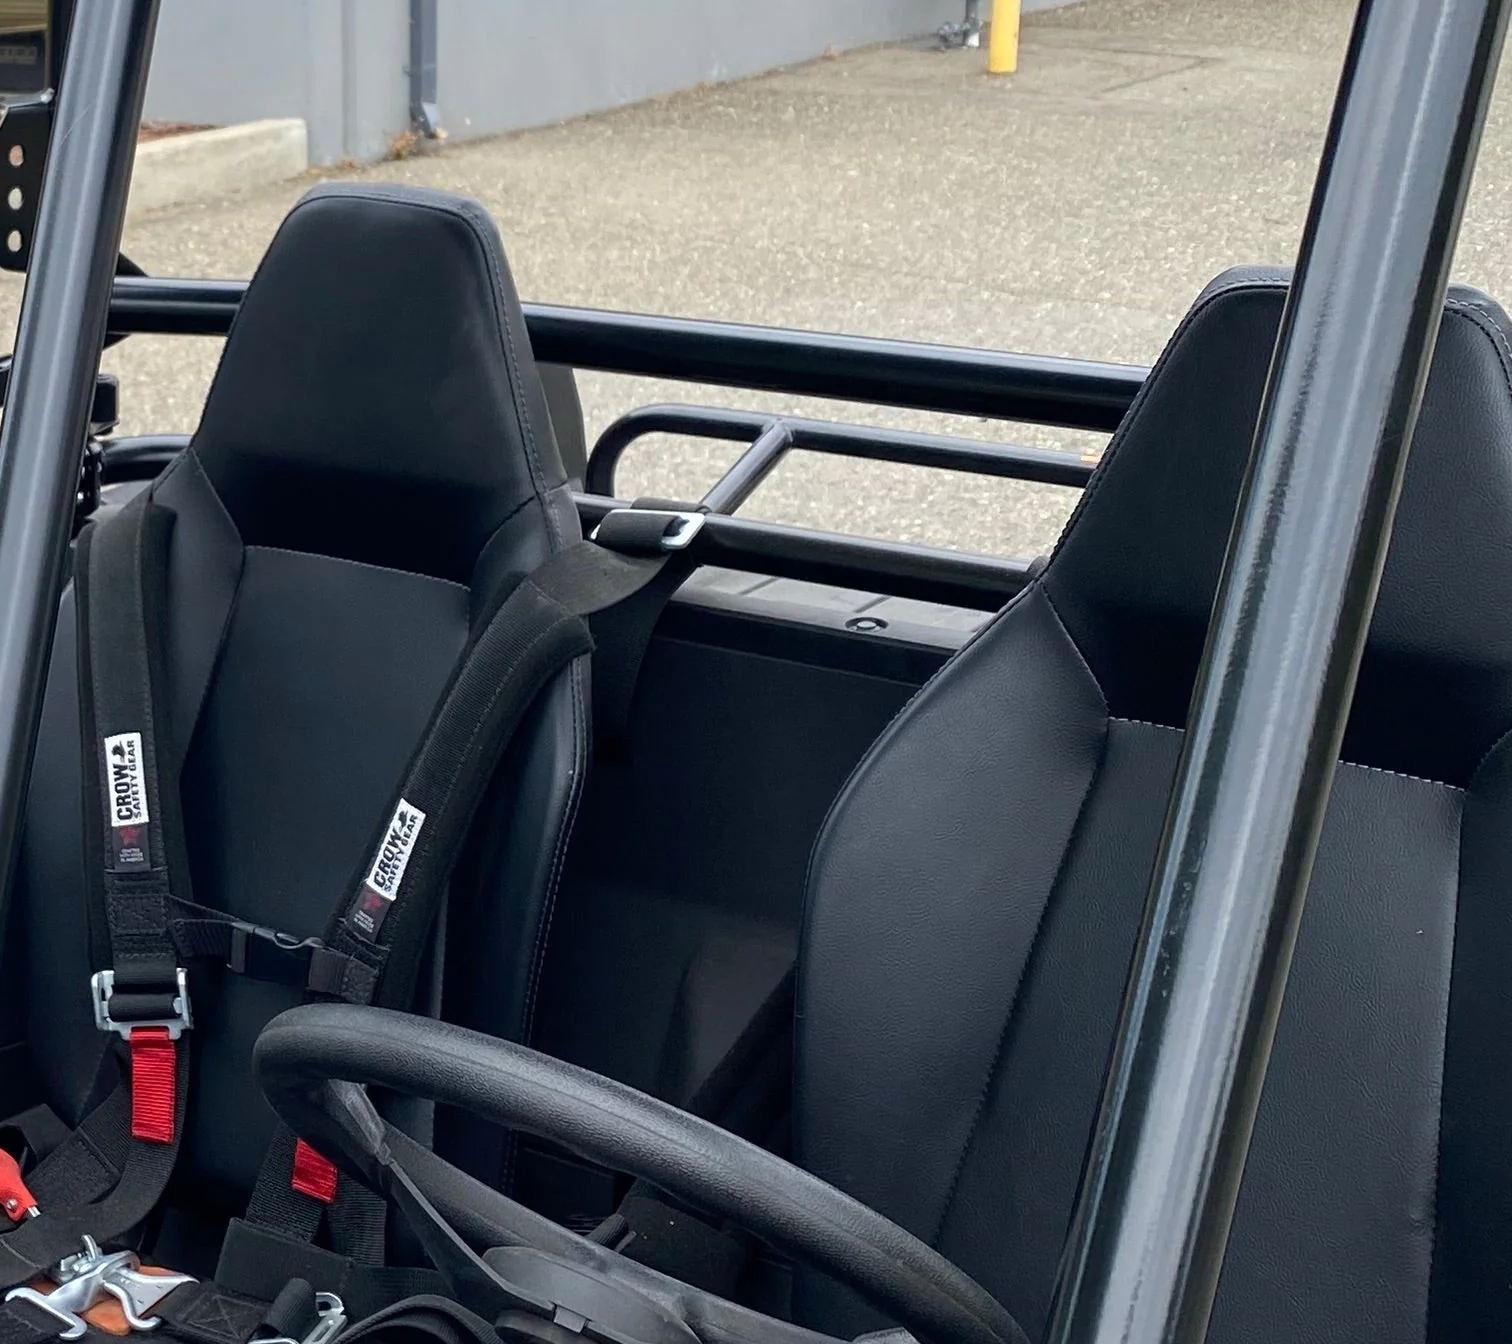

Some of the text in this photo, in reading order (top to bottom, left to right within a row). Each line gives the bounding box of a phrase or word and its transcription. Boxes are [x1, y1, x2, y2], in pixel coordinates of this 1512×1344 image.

[112, 762, 134, 821] CROW
[126, 739, 142, 819] SAFETY GEAR
[373, 827, 402, 888] CROW
[383, 814, 419, 892] SAFETY GEAR
